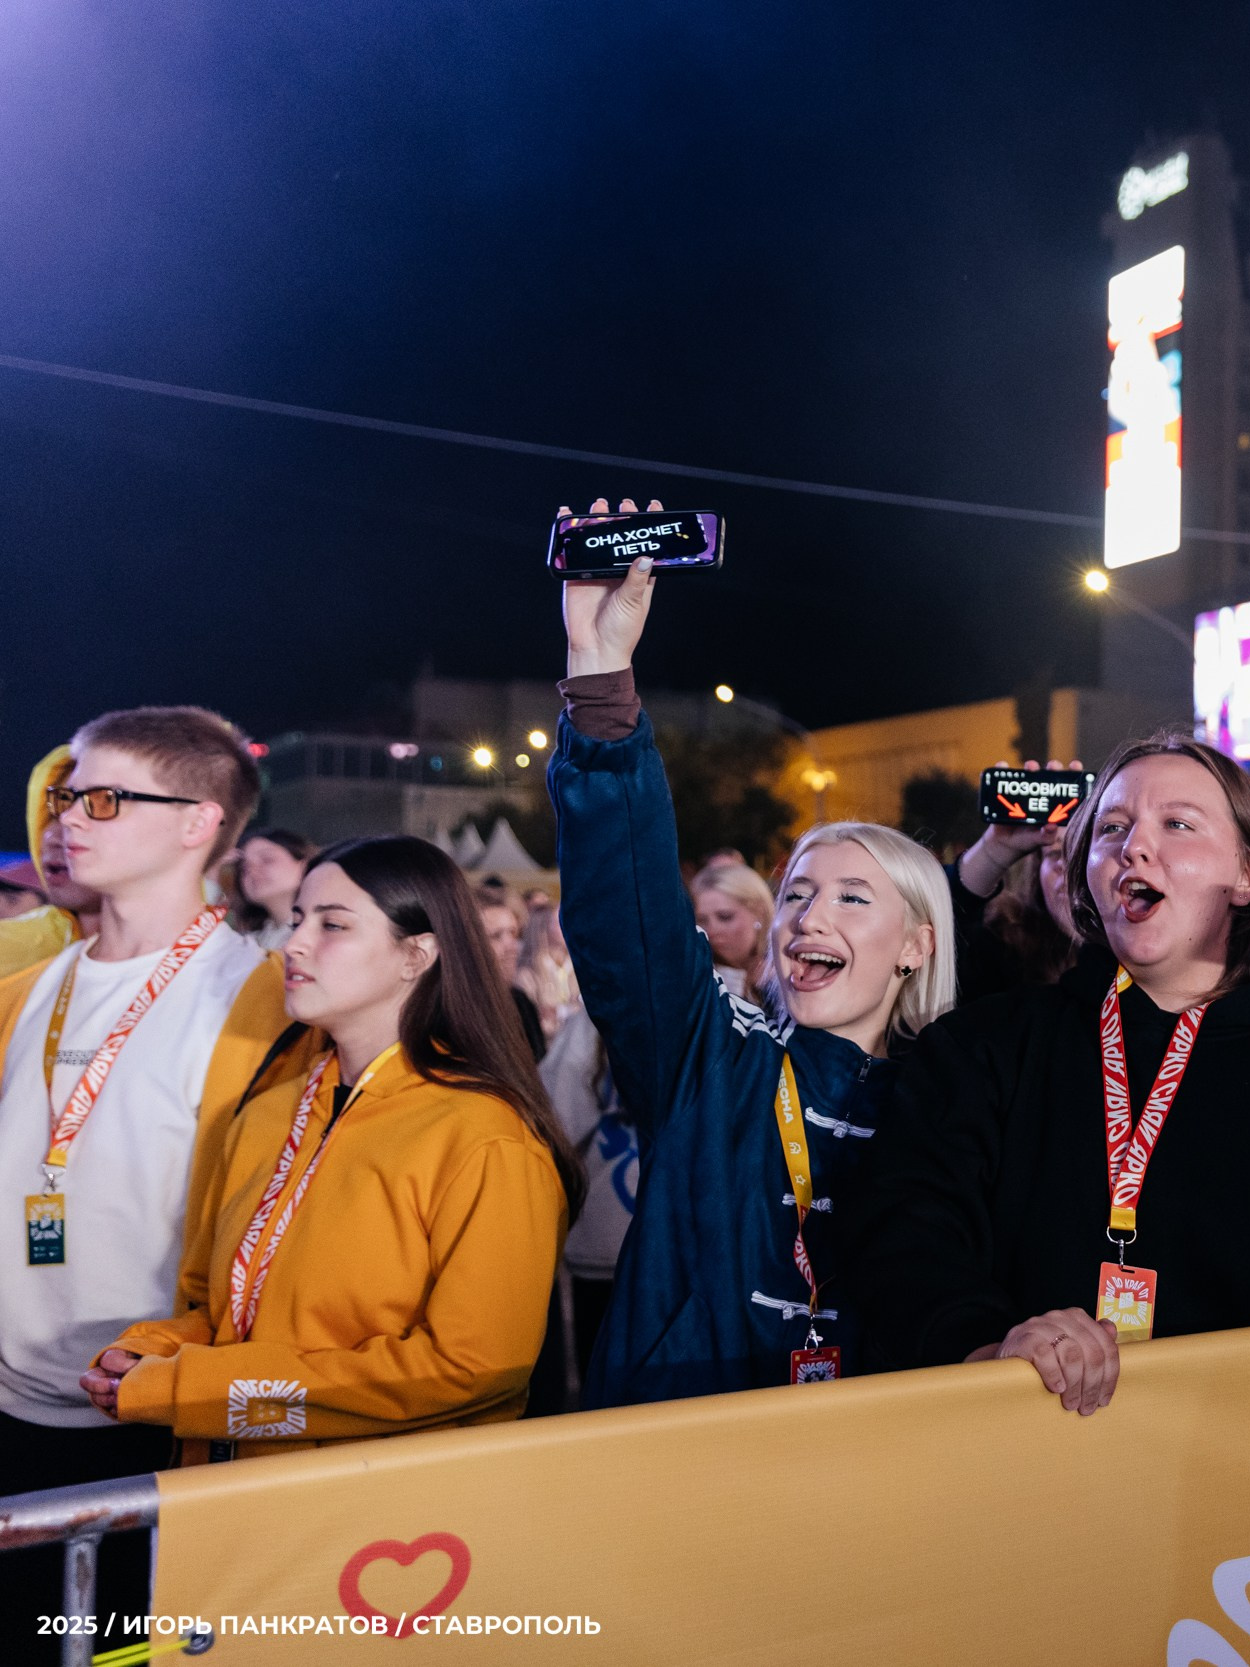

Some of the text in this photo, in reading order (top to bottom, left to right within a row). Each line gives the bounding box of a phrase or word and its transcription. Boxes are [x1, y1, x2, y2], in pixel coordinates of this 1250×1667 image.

[585, 521, 683, 548] ОНА ХОЧЕТ
[613, 540, 661, 557] ПЕТЬ
[997, 781, 1079, 798] ПОЗОВИТЕ
[1028, 796, 1050, 812] ЕЁ
[1101, 1012, 1126, 1078] ЯРКО
[1158, 1019, 1194, 1081] ЯРКО
[1113, 1136, 1148, 1206] ЯРКО
[795, 1232, 813, 1287] РКО
[233, 1379, 301, 1398] ВЕСНА
